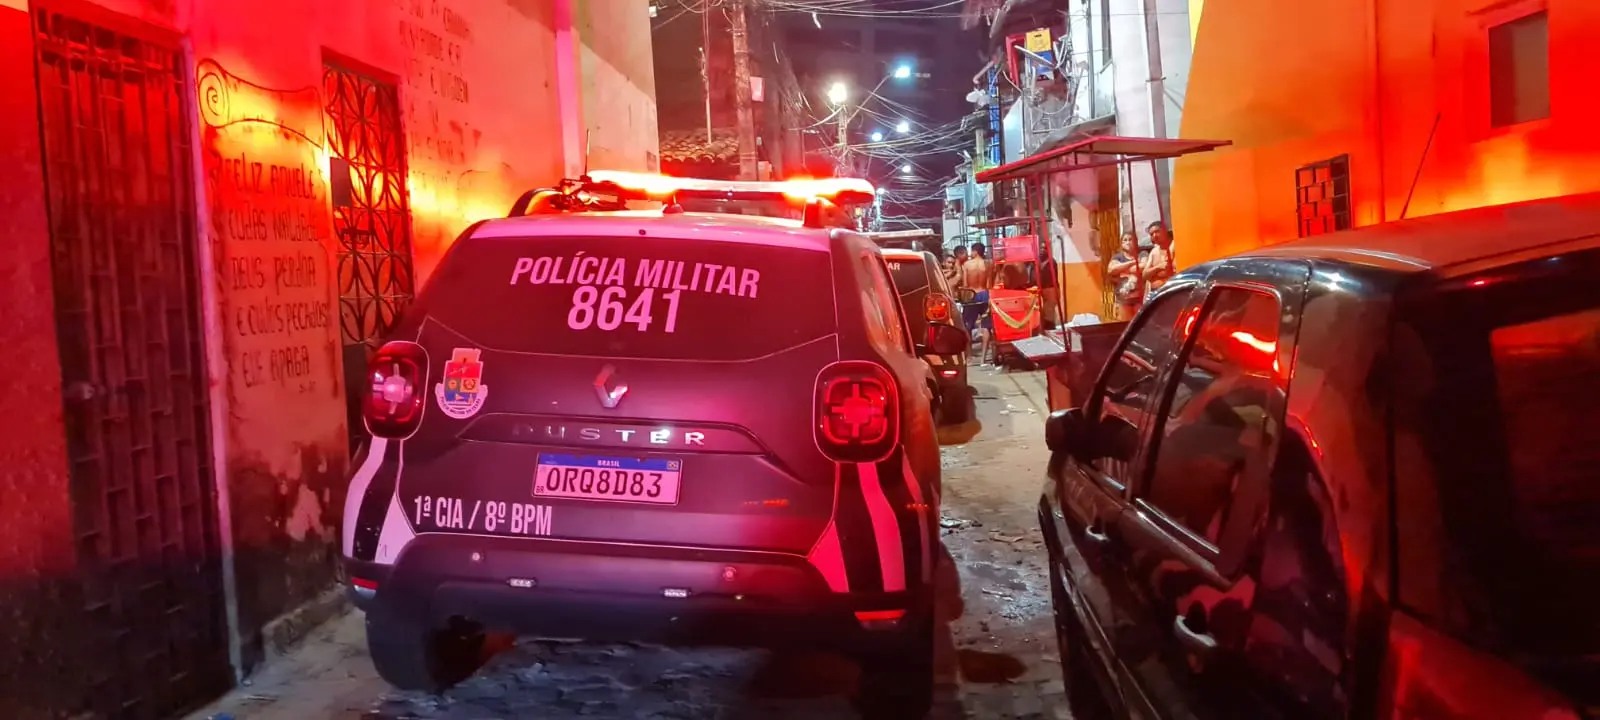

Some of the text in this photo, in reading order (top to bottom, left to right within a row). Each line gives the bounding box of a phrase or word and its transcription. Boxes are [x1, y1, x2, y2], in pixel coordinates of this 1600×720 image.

[231, 255, 265, 290] DEUS
[510, 251, 761, 298] POLÍCIA MILITAR
[236, 306, 247, 336] E
[567, 285, 681, 333] 8641
[270, 345, 310, 390] APAGA
[597, 459, 620, 468] BRASIL
[546, 467, 663, 498] ORQ8D83
[435, 496, 463, 529] CIA
[467, 500, 481, 530] /
[510, 503, 552, 536] BPM
